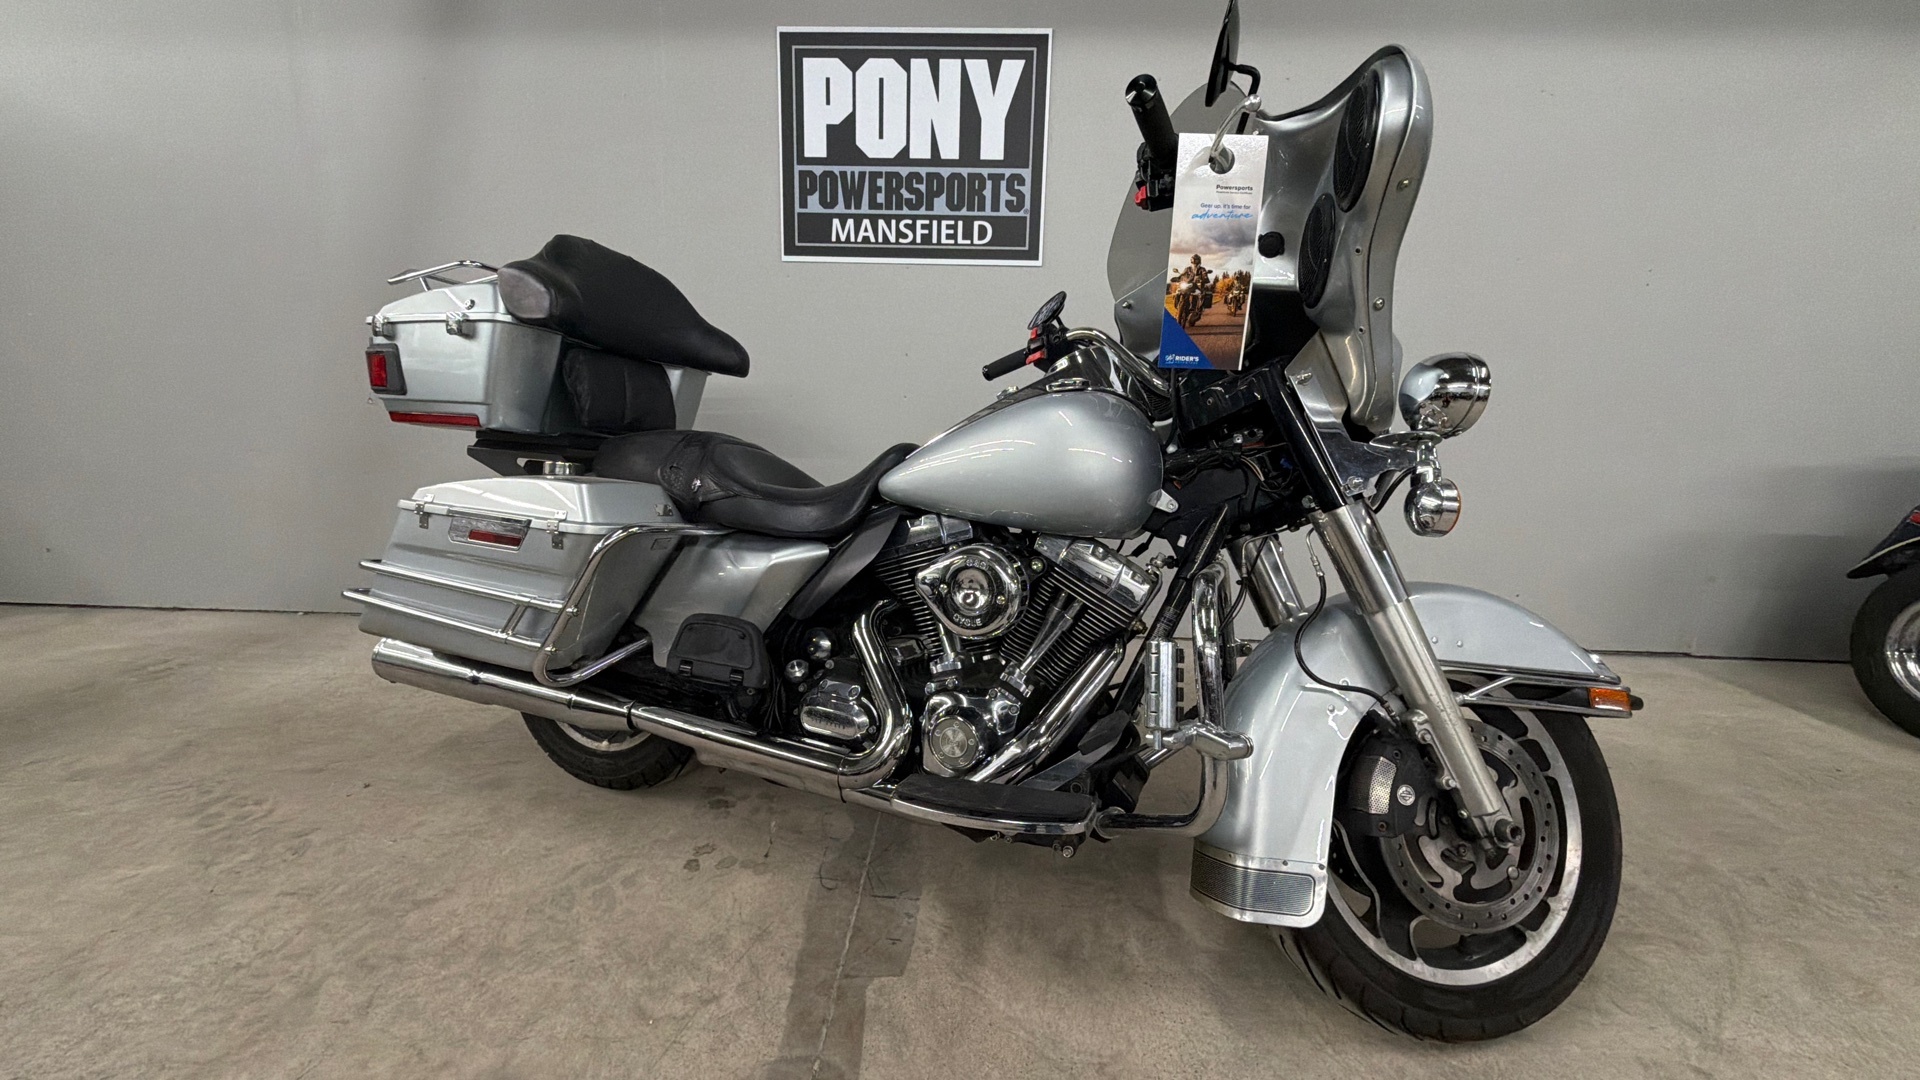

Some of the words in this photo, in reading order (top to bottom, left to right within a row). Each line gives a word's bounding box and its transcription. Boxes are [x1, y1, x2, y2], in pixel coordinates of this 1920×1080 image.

[803, 57, 1026, 160] PONY
[798, 170, 1026, 213] POWERSPORTS
[1191, 209, 1253, 219] adventure
[831, 218, 993, 245] MANSFIELD
[953, 613, 982, 626] CYCLE
